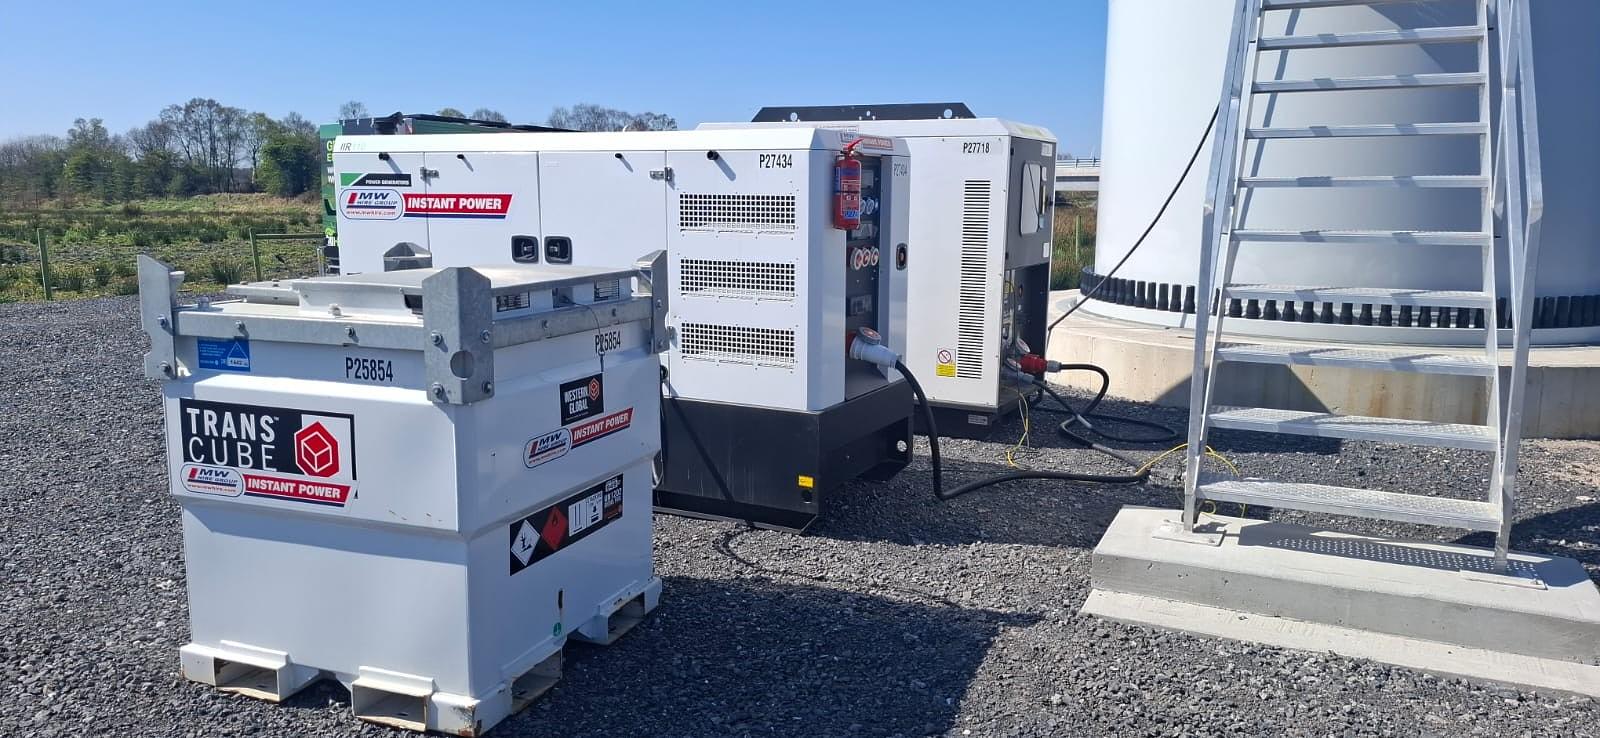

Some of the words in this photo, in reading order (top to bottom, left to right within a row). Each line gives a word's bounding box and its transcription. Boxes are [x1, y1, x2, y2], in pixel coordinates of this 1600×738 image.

[963, 142, 990, 154] P27718
[759, 154, 793, 168] P27434
[358, 192, 390, 200] MW
[407, 197, 457, 210] INSTANT
[459, 197, 502, 210] POWER
[595, 331, 621, 354] P25854
[345, 356, 394, 382] P25854
[564, 385, 588, 403] WESTERN
[569, 398, 589, 415] GLOBAL
[573, 421, 605, 440] INSTANT
[605, 412, 629, 429] POWER
[539, 431, 562, 446] MW
[188, 436, 278, 472] CUBE
[199, 468, 230, 478] MW
[248, 478, 296, 493] INSTANT
[299, 484, 341, 499] POWER
